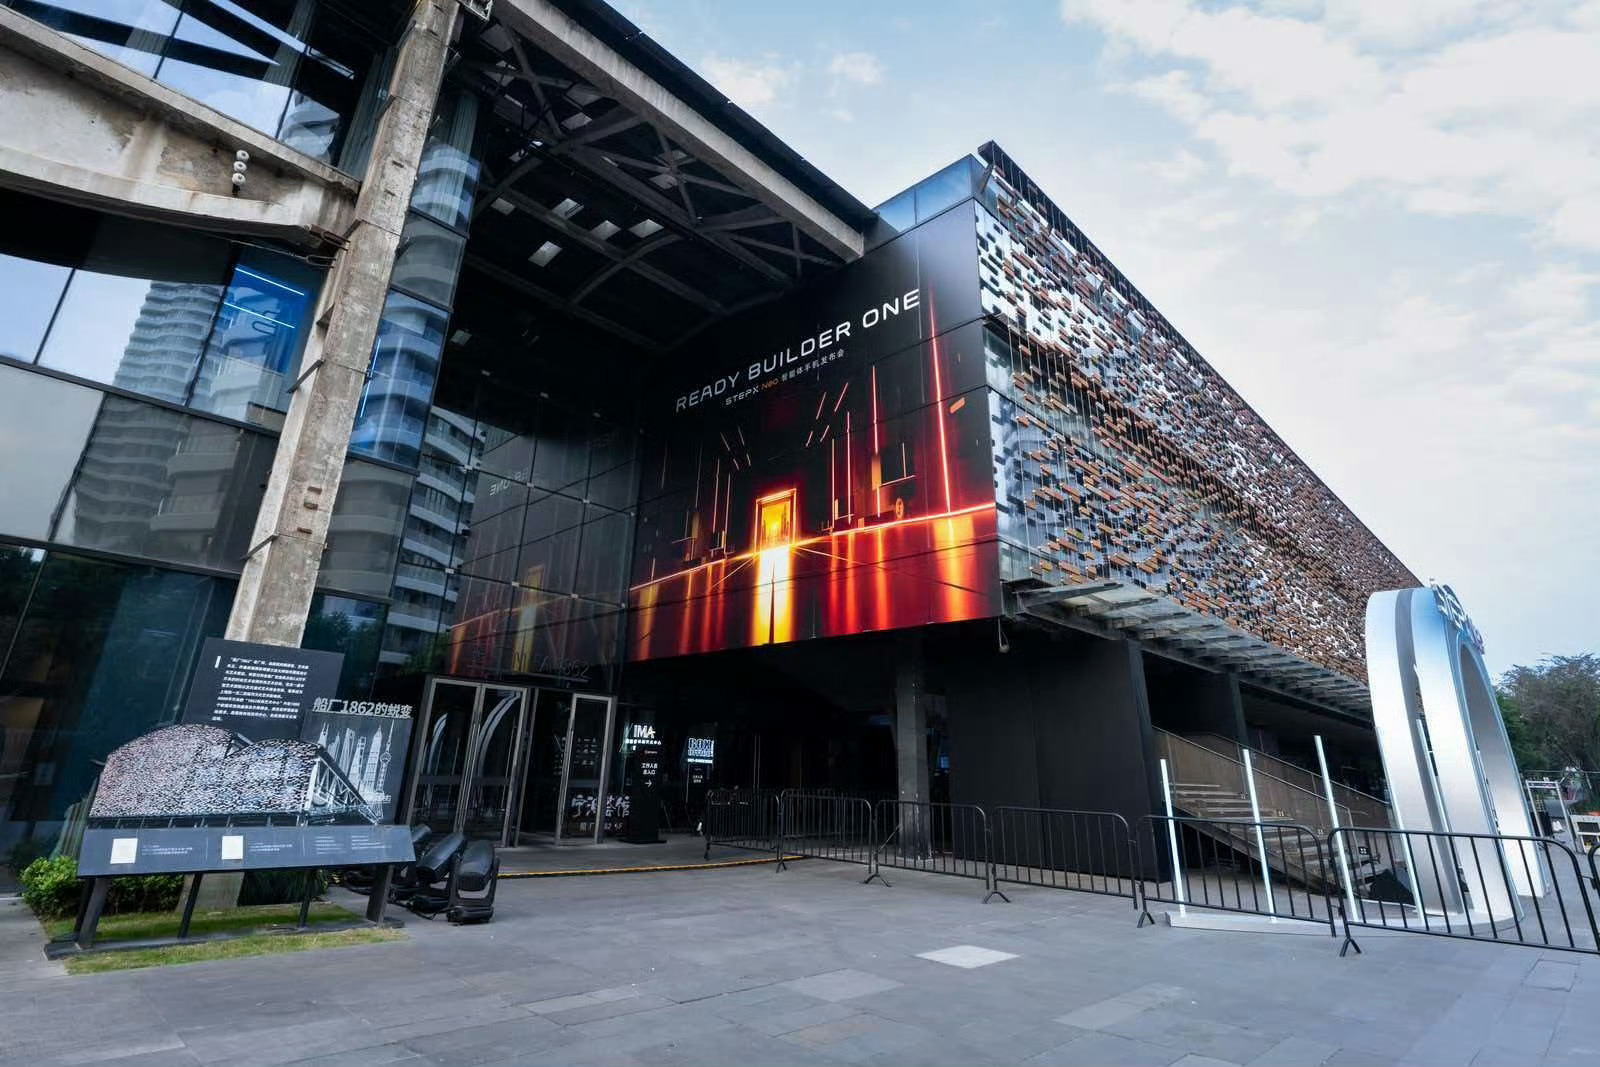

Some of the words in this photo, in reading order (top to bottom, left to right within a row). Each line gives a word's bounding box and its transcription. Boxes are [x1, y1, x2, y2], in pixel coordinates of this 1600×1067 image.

[675, 371, 740, 413] READY
[748, 320, 851, 381] BUILDER
[862, 288, 920, 329] ONE
[312, 697, 413, 718] 船厂1862的蜕变
